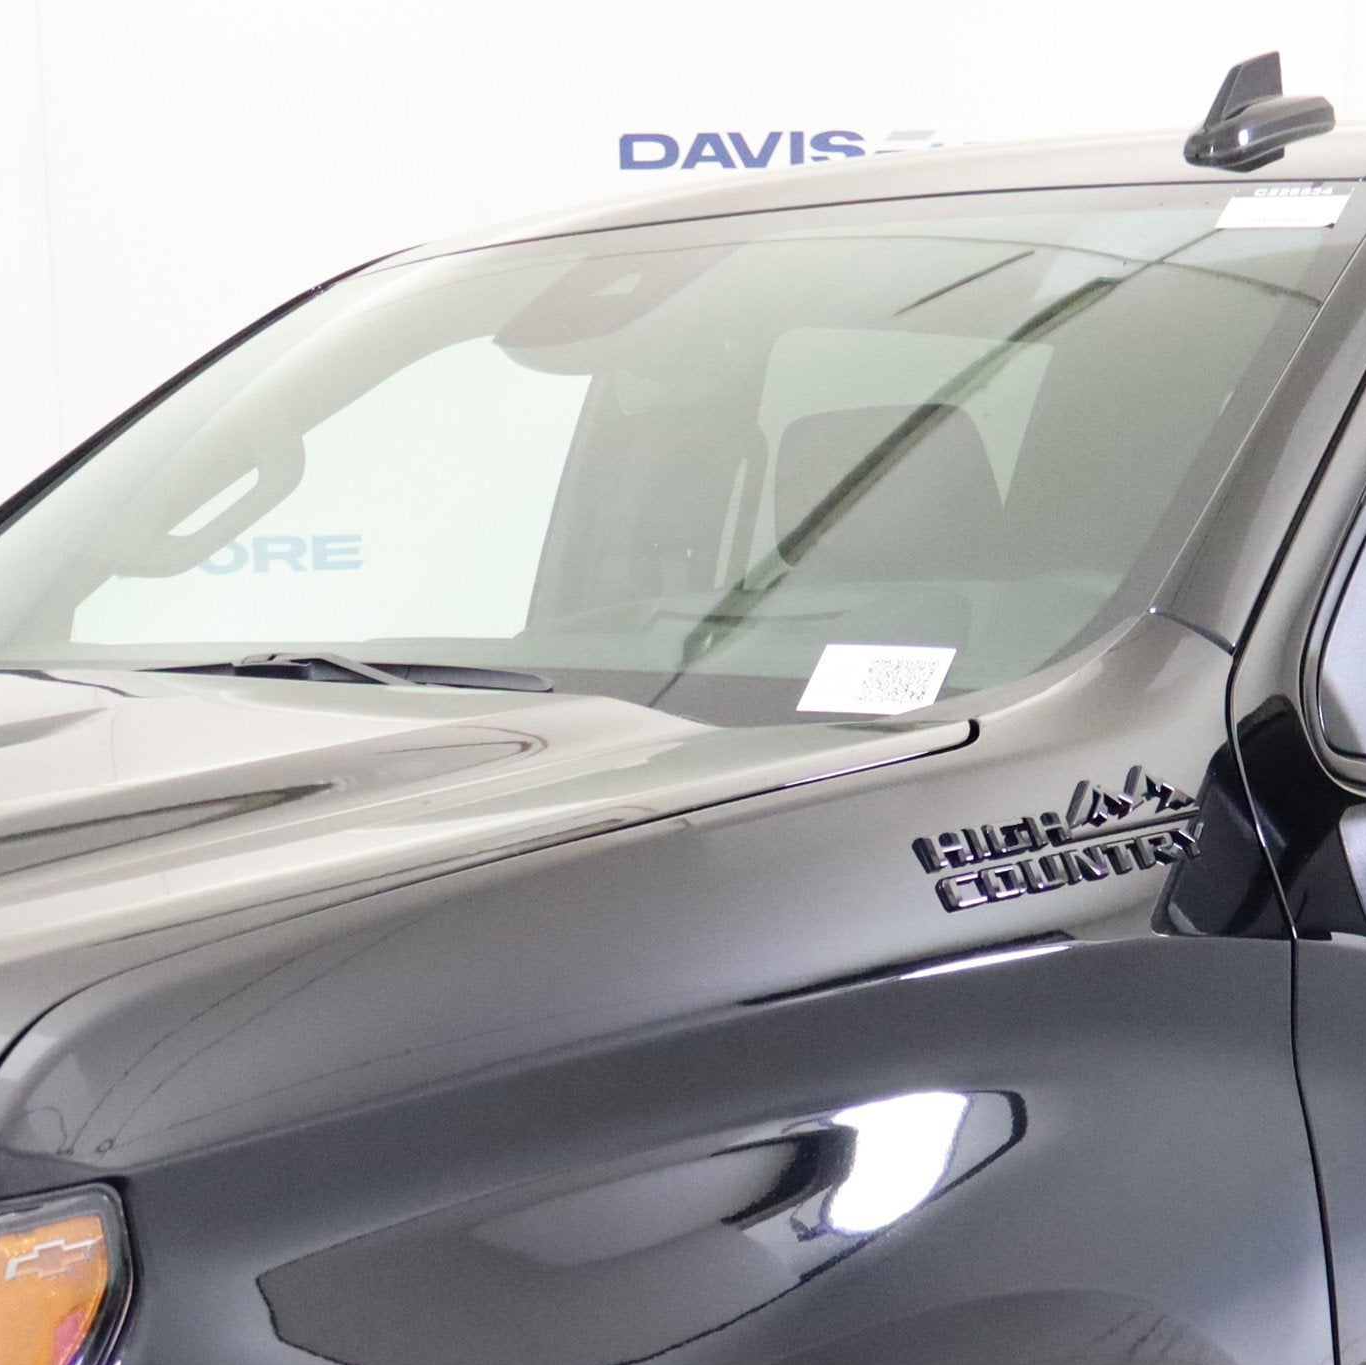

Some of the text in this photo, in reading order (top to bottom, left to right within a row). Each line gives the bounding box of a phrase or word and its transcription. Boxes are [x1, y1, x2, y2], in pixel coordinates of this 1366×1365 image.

[619, 130, 866, 170] DAVIS
[911, 812, 1073, 875] HIGH
[935, 821, 1202, 914] COUNTRY
